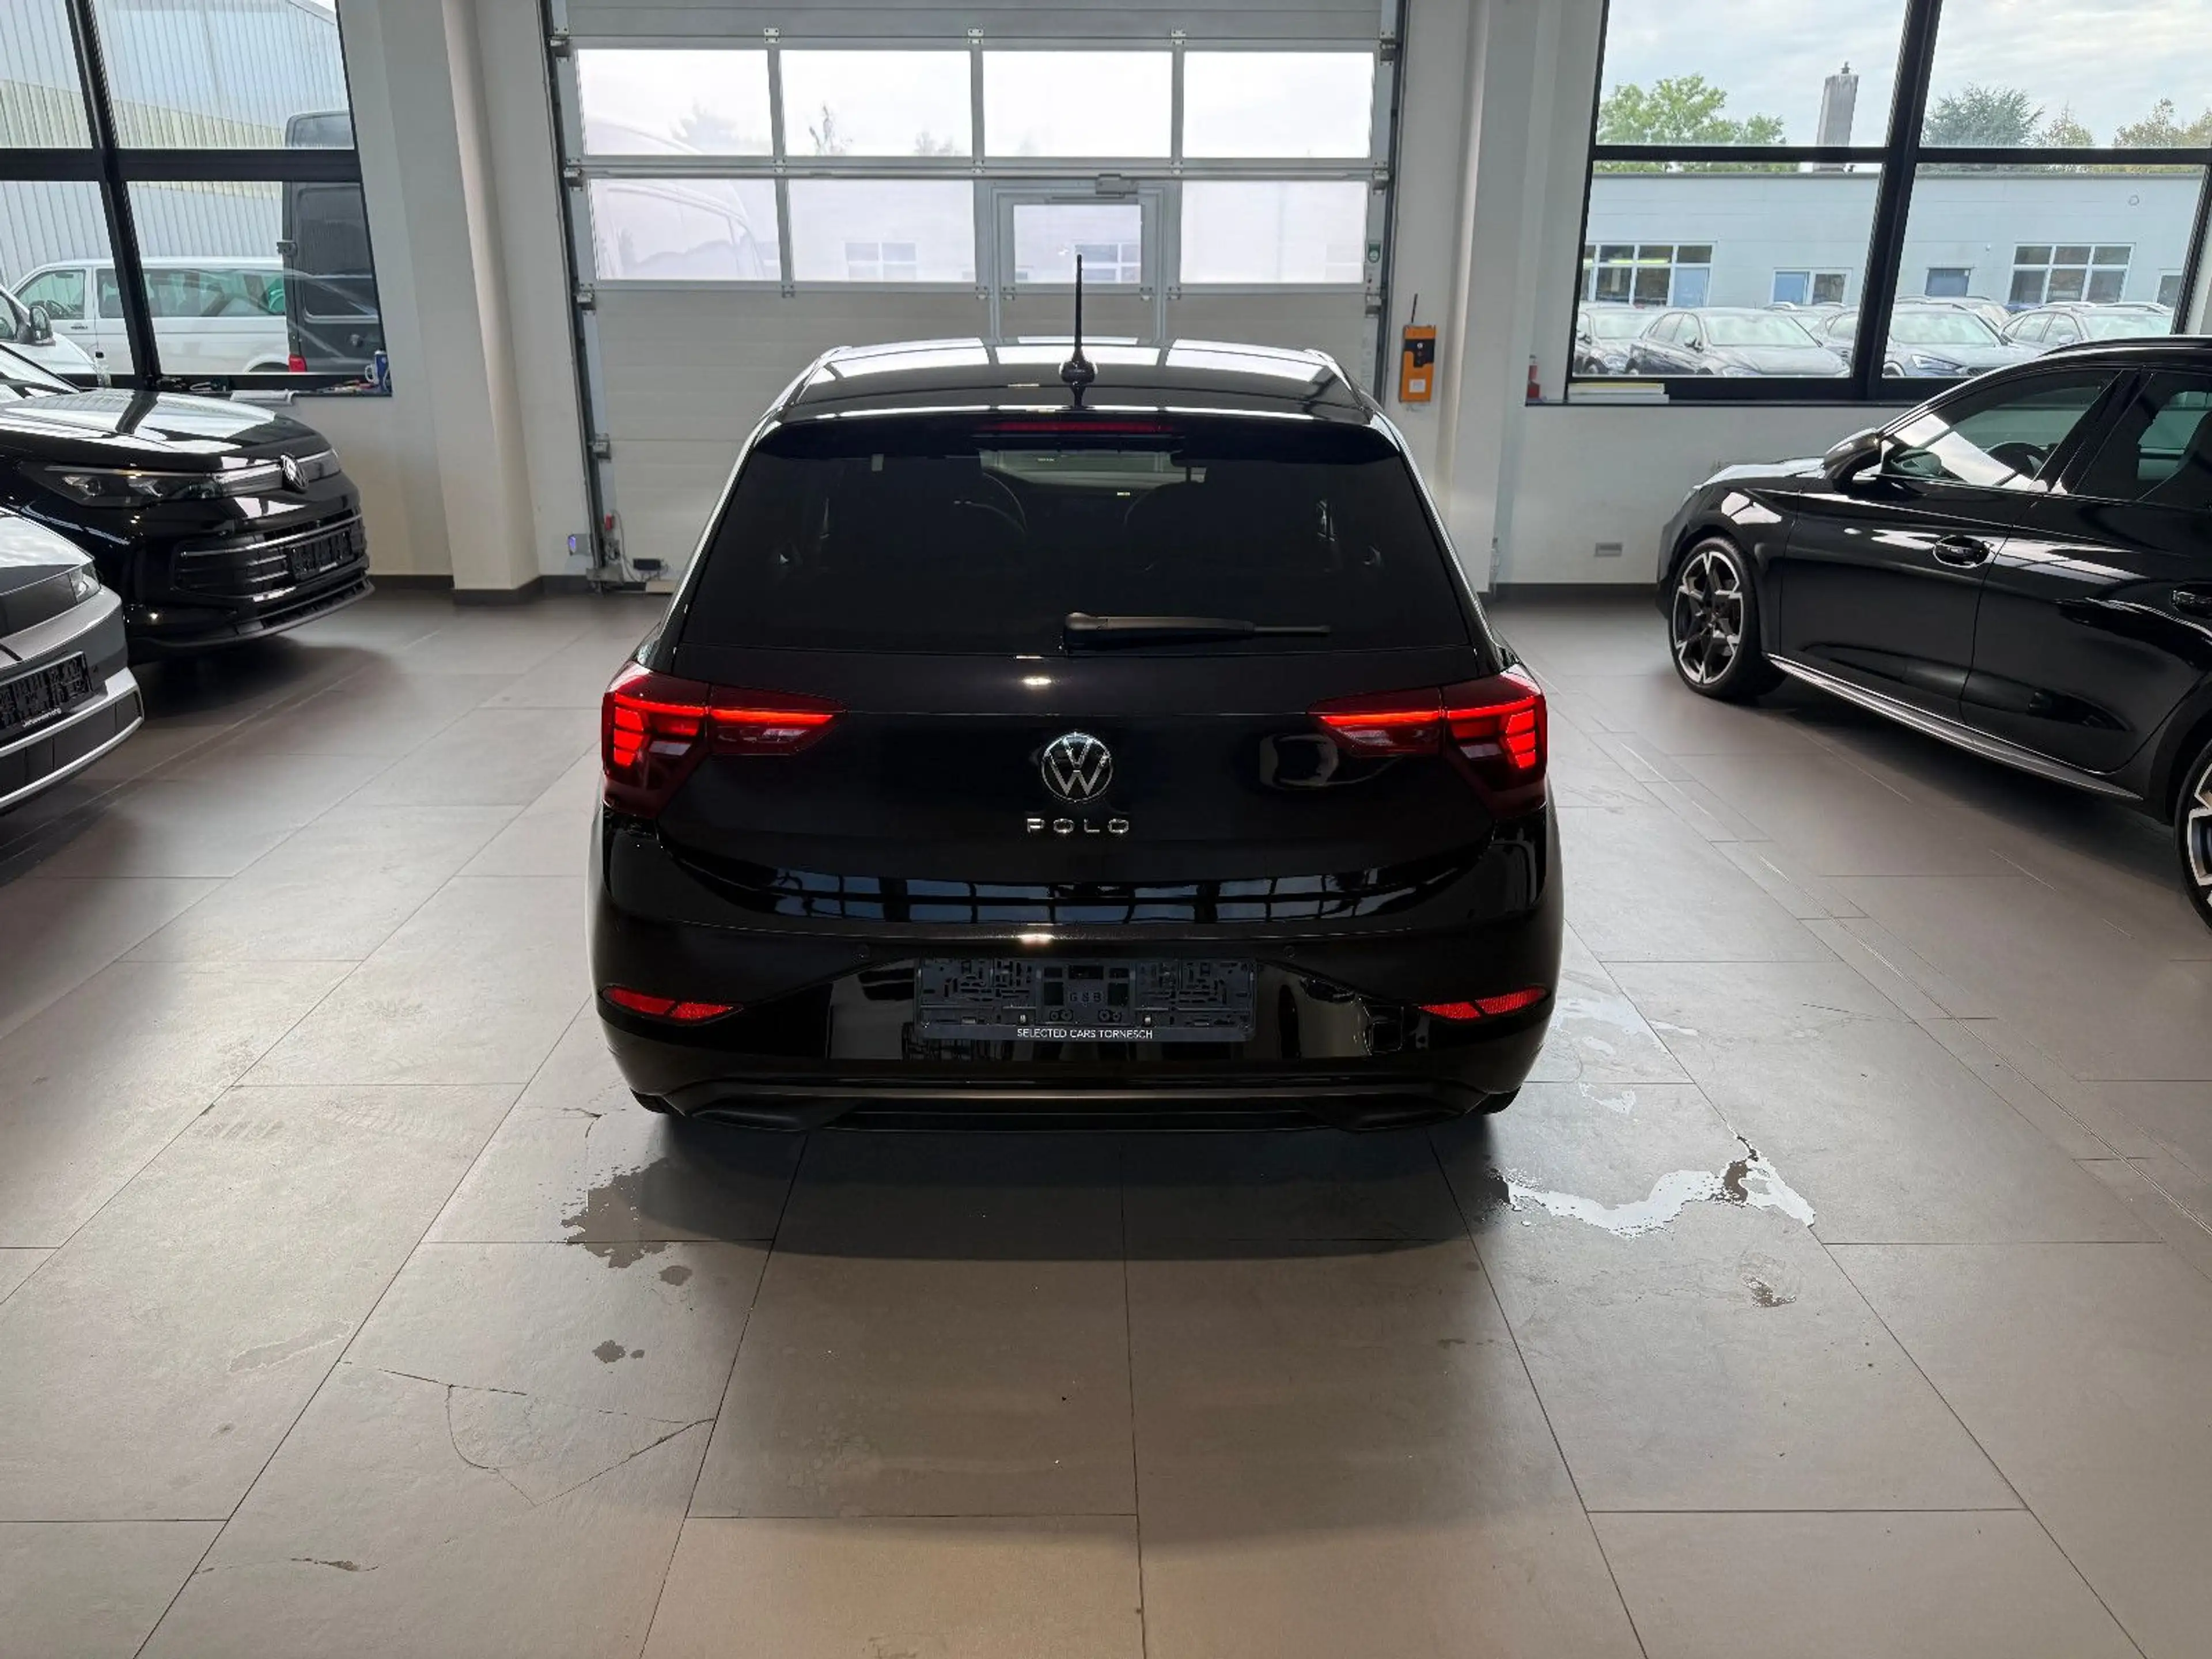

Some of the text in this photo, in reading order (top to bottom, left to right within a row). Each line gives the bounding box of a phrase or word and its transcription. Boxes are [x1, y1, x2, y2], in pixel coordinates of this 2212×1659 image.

[1043, 733, 1112, 801] VW
[1027, 817, 1130, 834] POLO
[1017, 1028, 1153, 1039] SELECTED CARS TORNESCH
